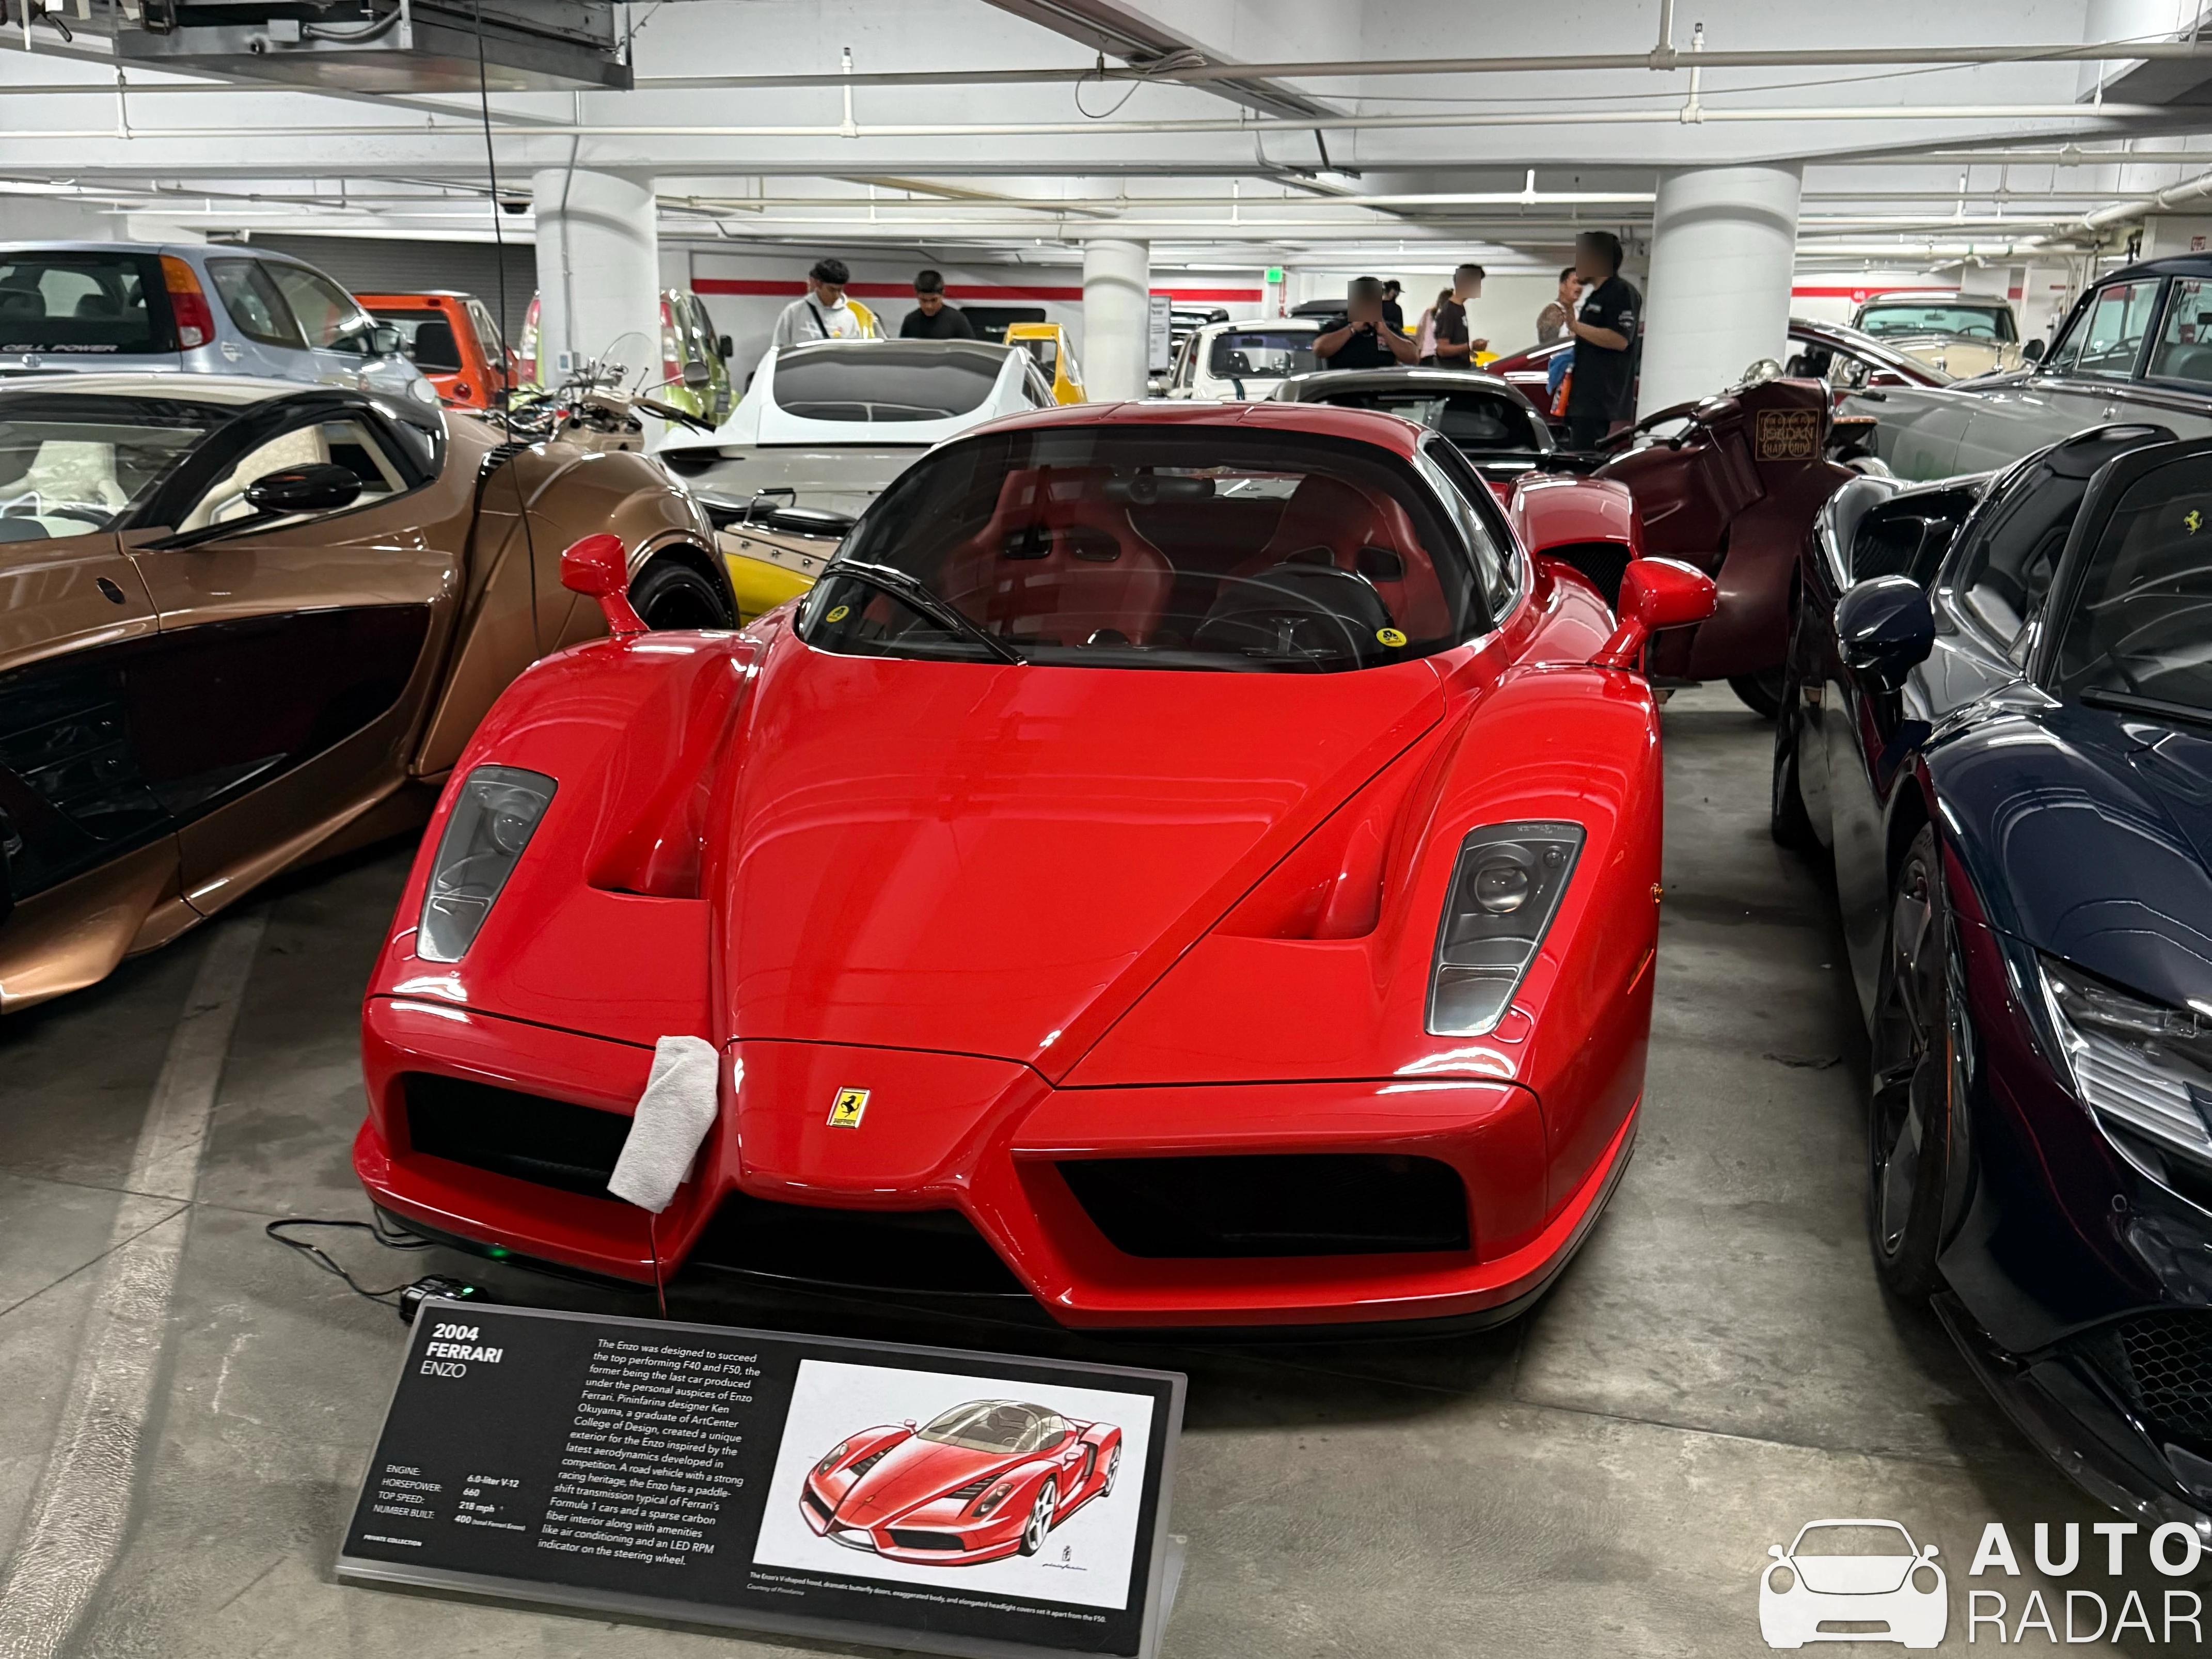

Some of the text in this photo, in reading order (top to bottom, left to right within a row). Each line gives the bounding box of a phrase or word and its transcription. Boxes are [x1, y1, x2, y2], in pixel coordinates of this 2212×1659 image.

[1759, 427, 1813, 441] JORDAN
[432, 1323, 479, 1340] 2004
[425, 1341, 503, 1363] FERRARI
[597, 1338, 615, 1349] The
[616, 1340, 639, 1351] Enzo
[660, 1345, 705, 1358] designed
[717, 1352, 757, 1363] succeed
[420, 1360, 466, 1378] ENZO
[588, 1363, 622, 1375] former
[622, 1367, 650, 1381] being
[651, 1370, 667, 1380] the
[668, 1371, 686, 1382] last
[703, 1377, 751, 1388] produced
[593, 1351, 761, 1376] the top performing F40 and F50, the
[581, 1389, 730, 1413] Ferrari. Pininfarina designer Ken
[584, 1378, 752, 1402] under the personal auspices of Enzo
[577, 1402, 624, 1417] Okuyama,
[633, 1410, 677, 1422] graduate
[678, 1413, 691, 1423] of
[690, 1415, 739, 1428] ArtCenter
[573, 1416, 611, 1430] College
[612, 1420, 625, 1429] of
[624, 1421, 659, 1435] Design,
[661, 1428, 700, 1438] created
[708, 1431, 742, 1444] unique
[565, 1442, 724, 1468] latest aerodynamics developed in
[569, 1431, 738, 1457] exterior for the Enzo inspired by the
[467, 1475, 519, 1487] 6.0-liter V-12
[558, 1471, 587, 1483] racing
[587, 1472, 627, 1488] heritage,
[628, 1477, 645, 1488] the
[645, 1479, 669, 1491] Enzo
[669, 1481, 687, 1493] has
[694, 1486, 732, 1497] paddle-
[561, 1458, 618, 1471] competition.
[618, 1462, 627, 1472] A
[628, 1465, 652, 1474] road
[652, 1466, 684, 1478] vehicle
[685, 1470, 705, 1480] with
[713, 1475, 744, 1488] strong
[378, 1491, 424, 1503] TOP SPEED:
[463, 1488, 480, 1496] 660
[552, 1482, 720, 1511] shift transmission typical of Ferrari's
[373, 1504, 434, 1519] NUMBER BUILT:
[454, 1514, 471, 1523] 400
[458, 1501, 495, 1513] 218 mph
[549, 1496, 589, 1510] Formula
[591, 1501, 597, 1510] 1
[597, 1504, 619, 1513] cars
[619, 1506, 640, 1515] and
[647, 1510, 681, 1521] sparse
[681, 1513, 716, 1525] carbon
[545, 1509, 703, 1538] fiber interior along with amenities
[541, 1523, 715, 1554] like air conditioning and an LED RPM
[537, 1538, 686, 1566] indicator on the steering wheel.
